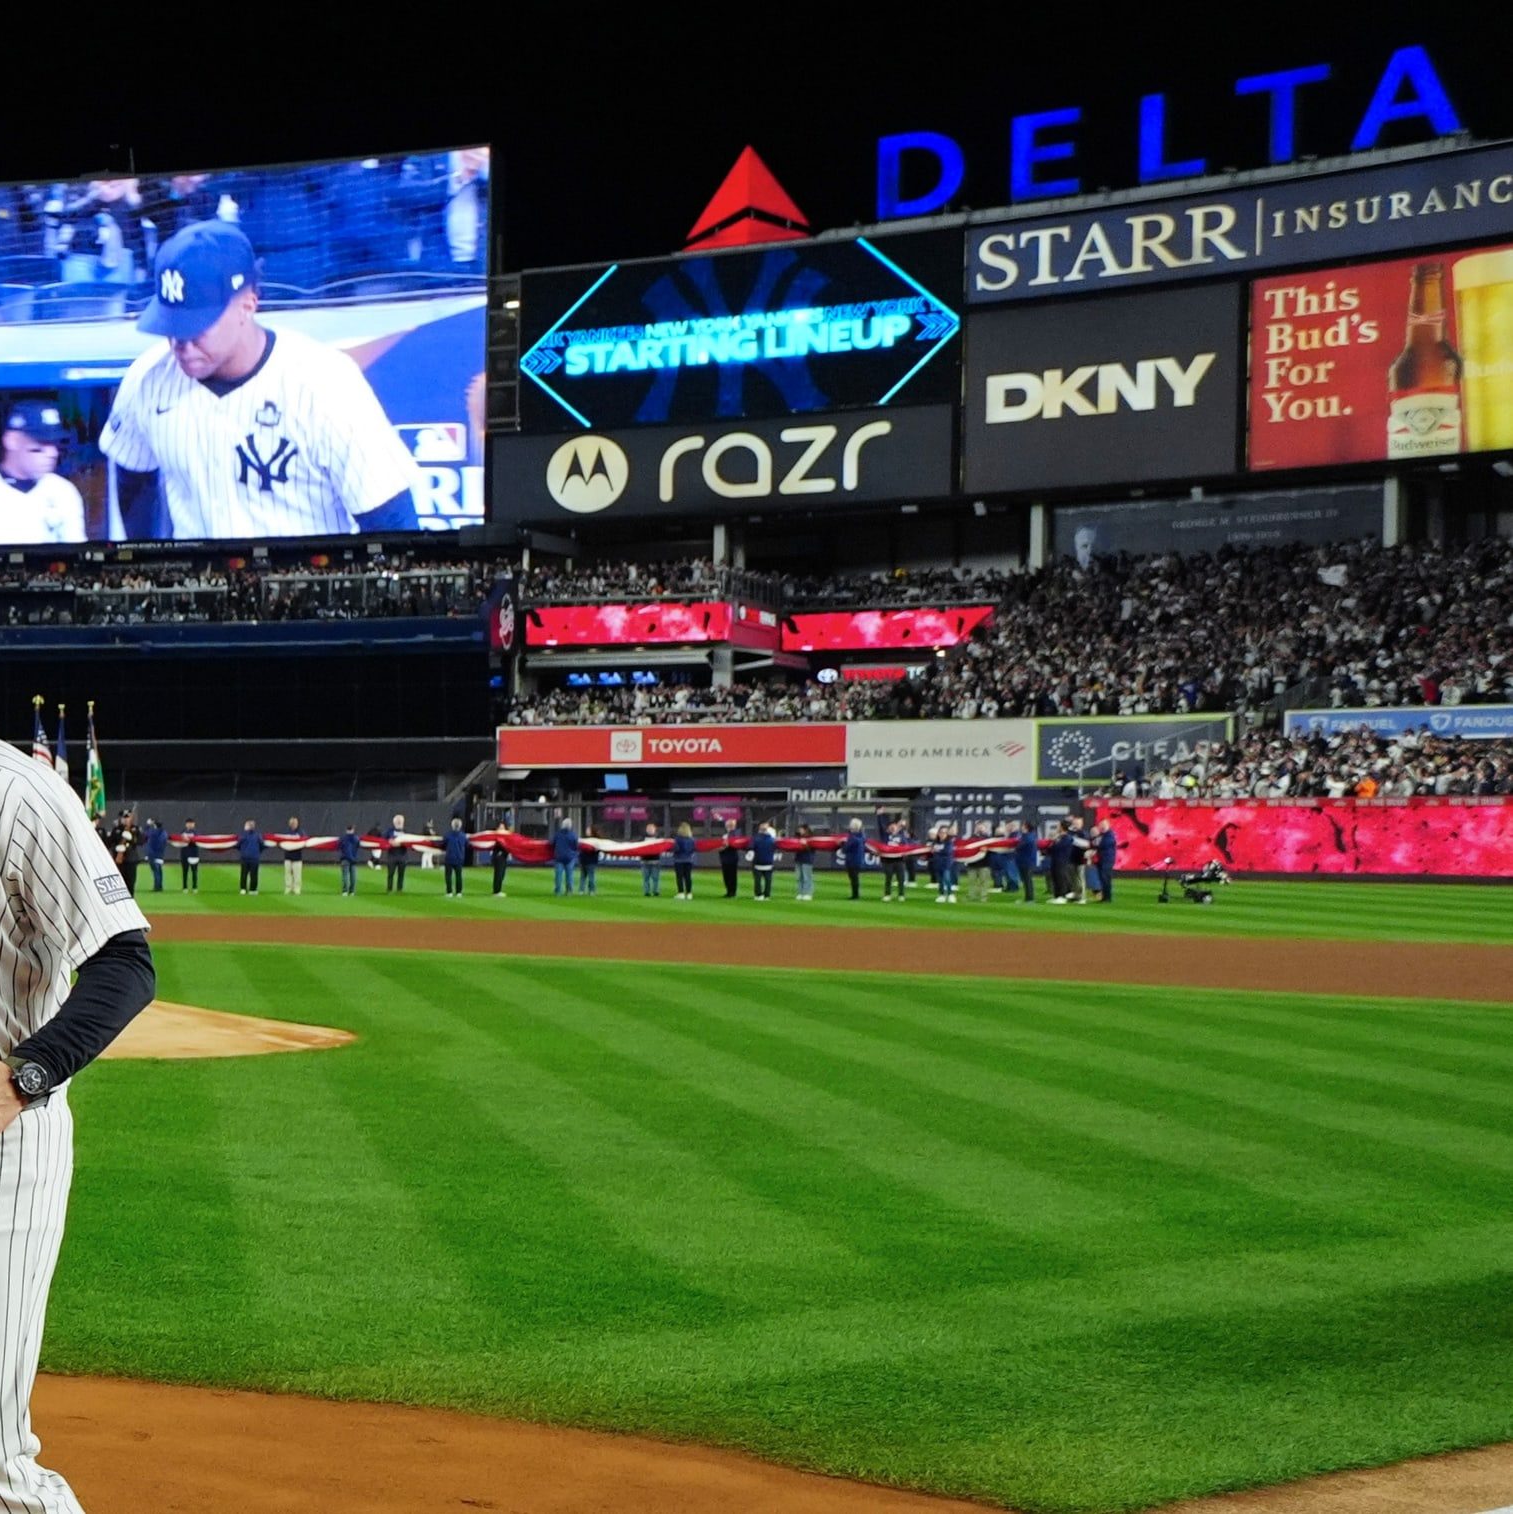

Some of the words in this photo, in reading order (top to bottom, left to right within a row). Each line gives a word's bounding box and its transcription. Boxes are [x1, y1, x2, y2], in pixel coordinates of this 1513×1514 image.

[876, 44, 1464, 220] DELTA
[974, 203, 1247, 293] STARR
[1271, 174, 1513, 238] INSURANC
[1264, 280, 1360, 320] This
[564, 329, 758, 376] STARTING
[763, 315, 912, 358] LINEUP
[1264, 312, 1380, 355] Bud's
[985, 352, 1217, 425] DKNY
[1263, 356, 1335, 389] For
[1262, 391, 1353, 424] You.
[659, 421, 891, 503] razr
[1453, 715, 1513, 728] FANDUE
[648, 738, 723, 754] TOYOTA
[853, 748, 893, 760] BANK
[898, 748, 918, 759] OF
[921, 747, 991, 759] AMERICA
